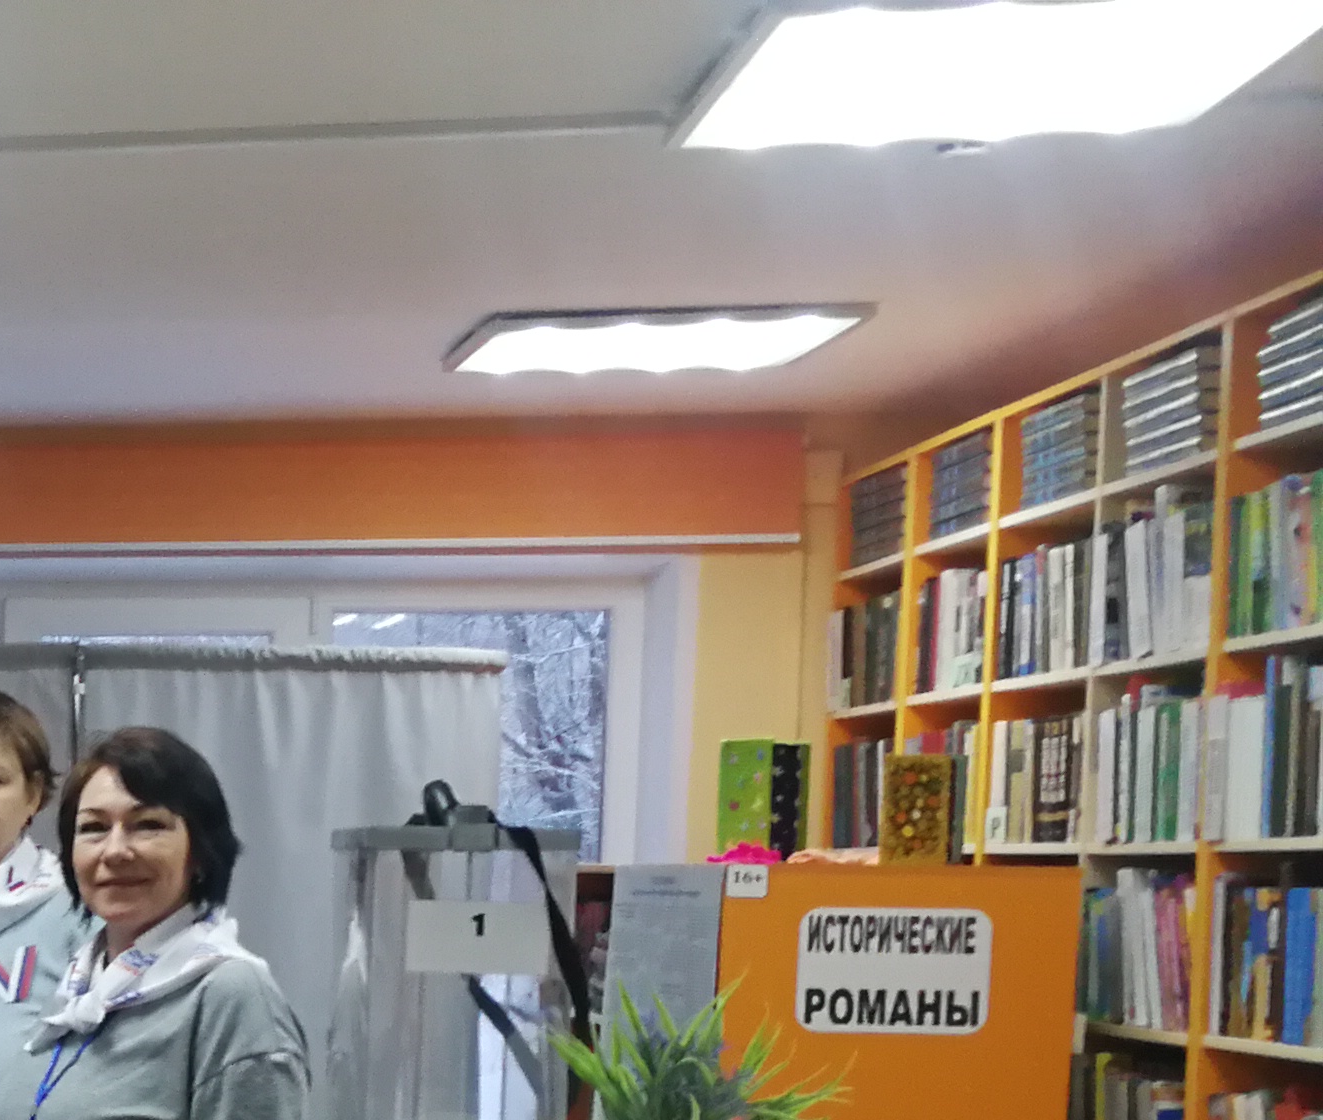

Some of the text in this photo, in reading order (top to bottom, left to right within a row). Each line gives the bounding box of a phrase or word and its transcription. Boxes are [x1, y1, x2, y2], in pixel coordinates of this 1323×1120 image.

[733, 870, 764, 885] 16+
[472, 913, 486, 936] 1
[807, 915, 976, 954] ИСТОРИЧЕСКИЕ
[804, 988, 980, 1027] РОМАНЫ
